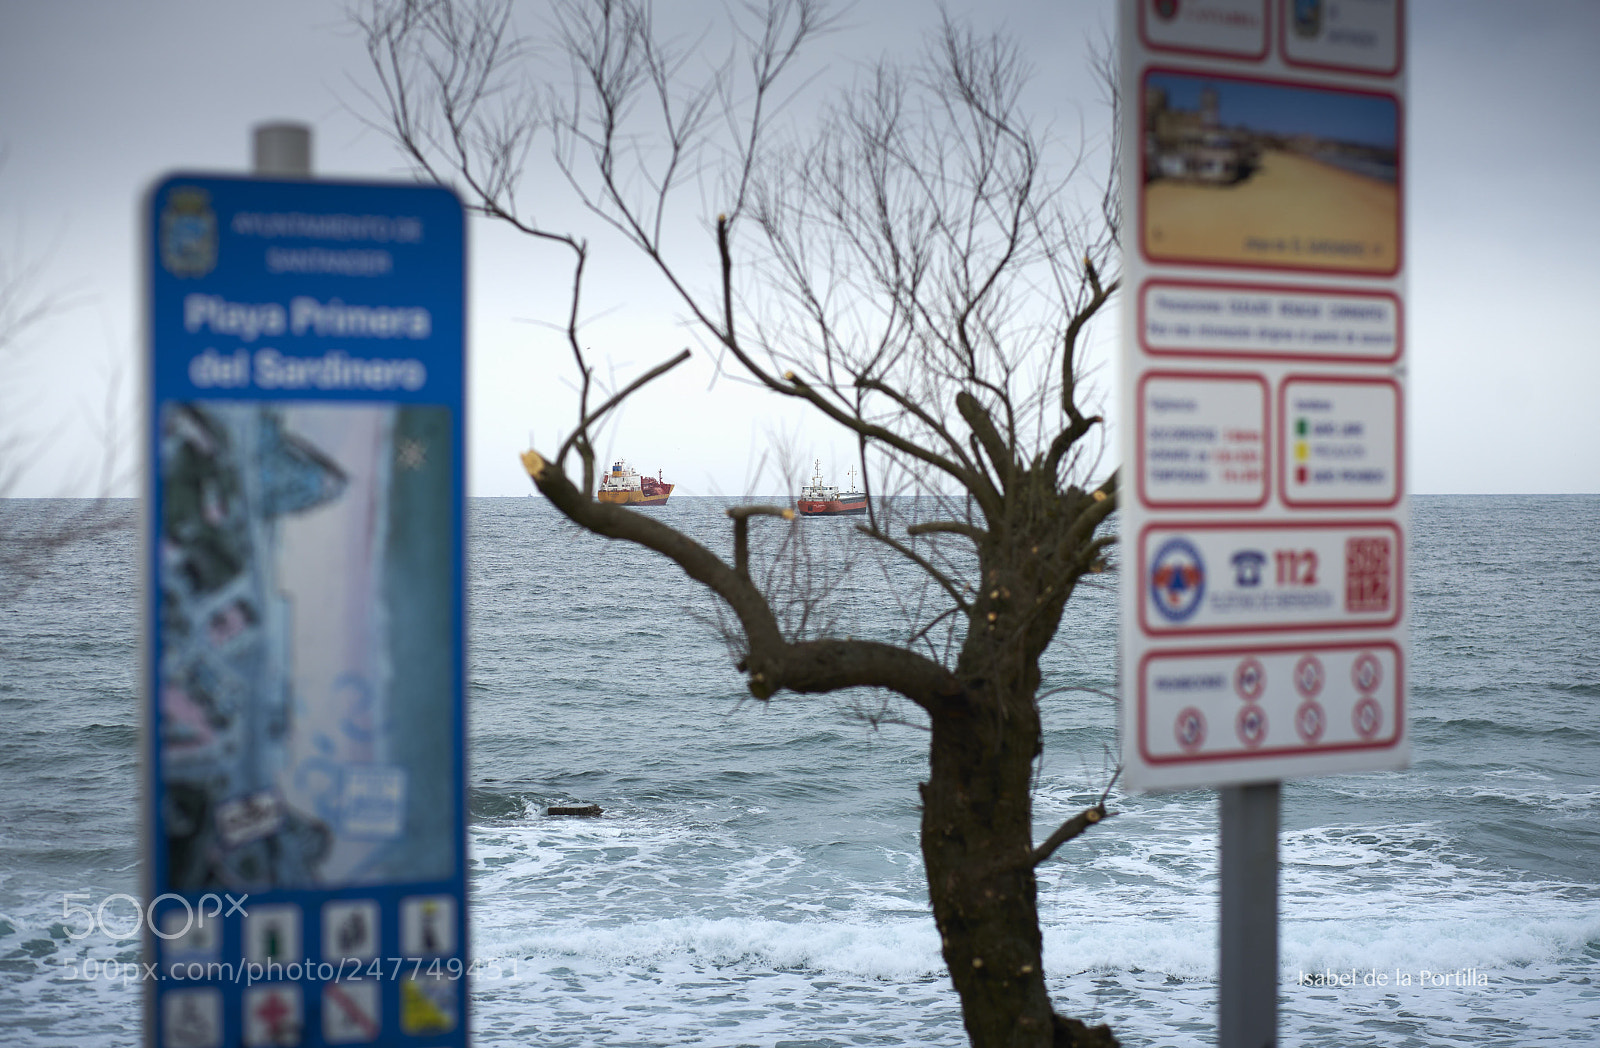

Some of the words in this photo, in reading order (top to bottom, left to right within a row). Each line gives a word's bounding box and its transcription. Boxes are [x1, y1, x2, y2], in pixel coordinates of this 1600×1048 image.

[185, 295, 285, 340] Playa
[291, 297, 430, 338] Primera
[190, 349, 250, 387] del
[254, 349, 425, 389] Sardinero
[1274, 548, 1319, 587] 112
